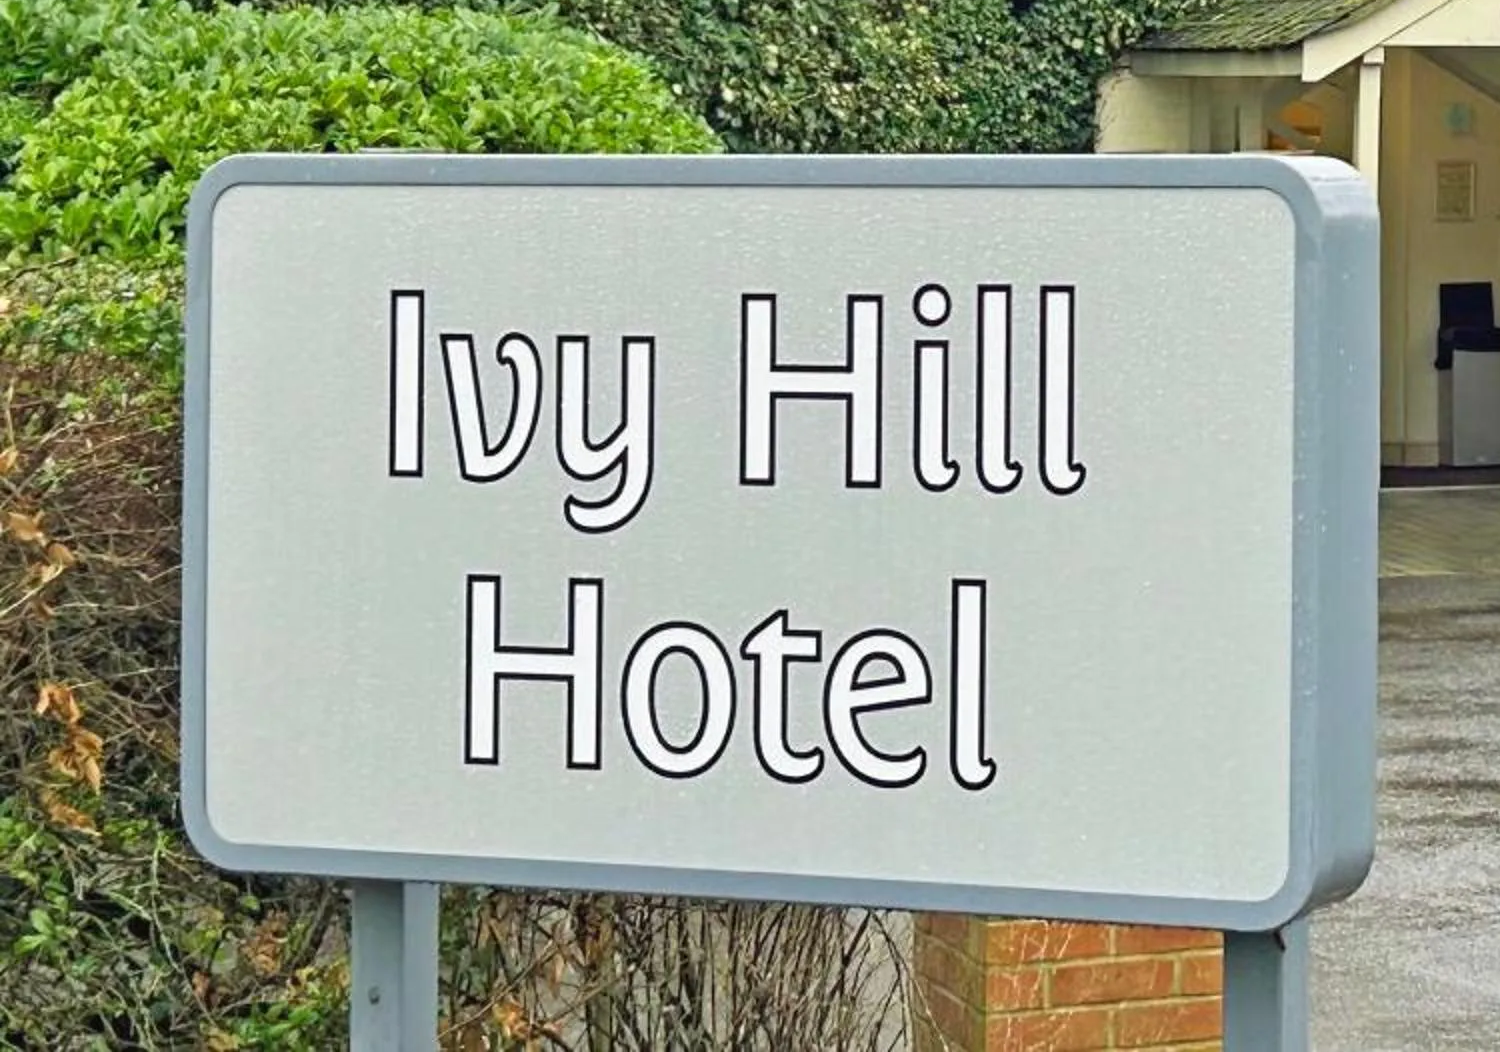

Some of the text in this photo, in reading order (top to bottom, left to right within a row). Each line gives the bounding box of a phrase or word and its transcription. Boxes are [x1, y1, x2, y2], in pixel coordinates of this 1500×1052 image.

[389, 283, 1086, 533] Ivy Hill
[464, 574, 997, 790] Hotel
